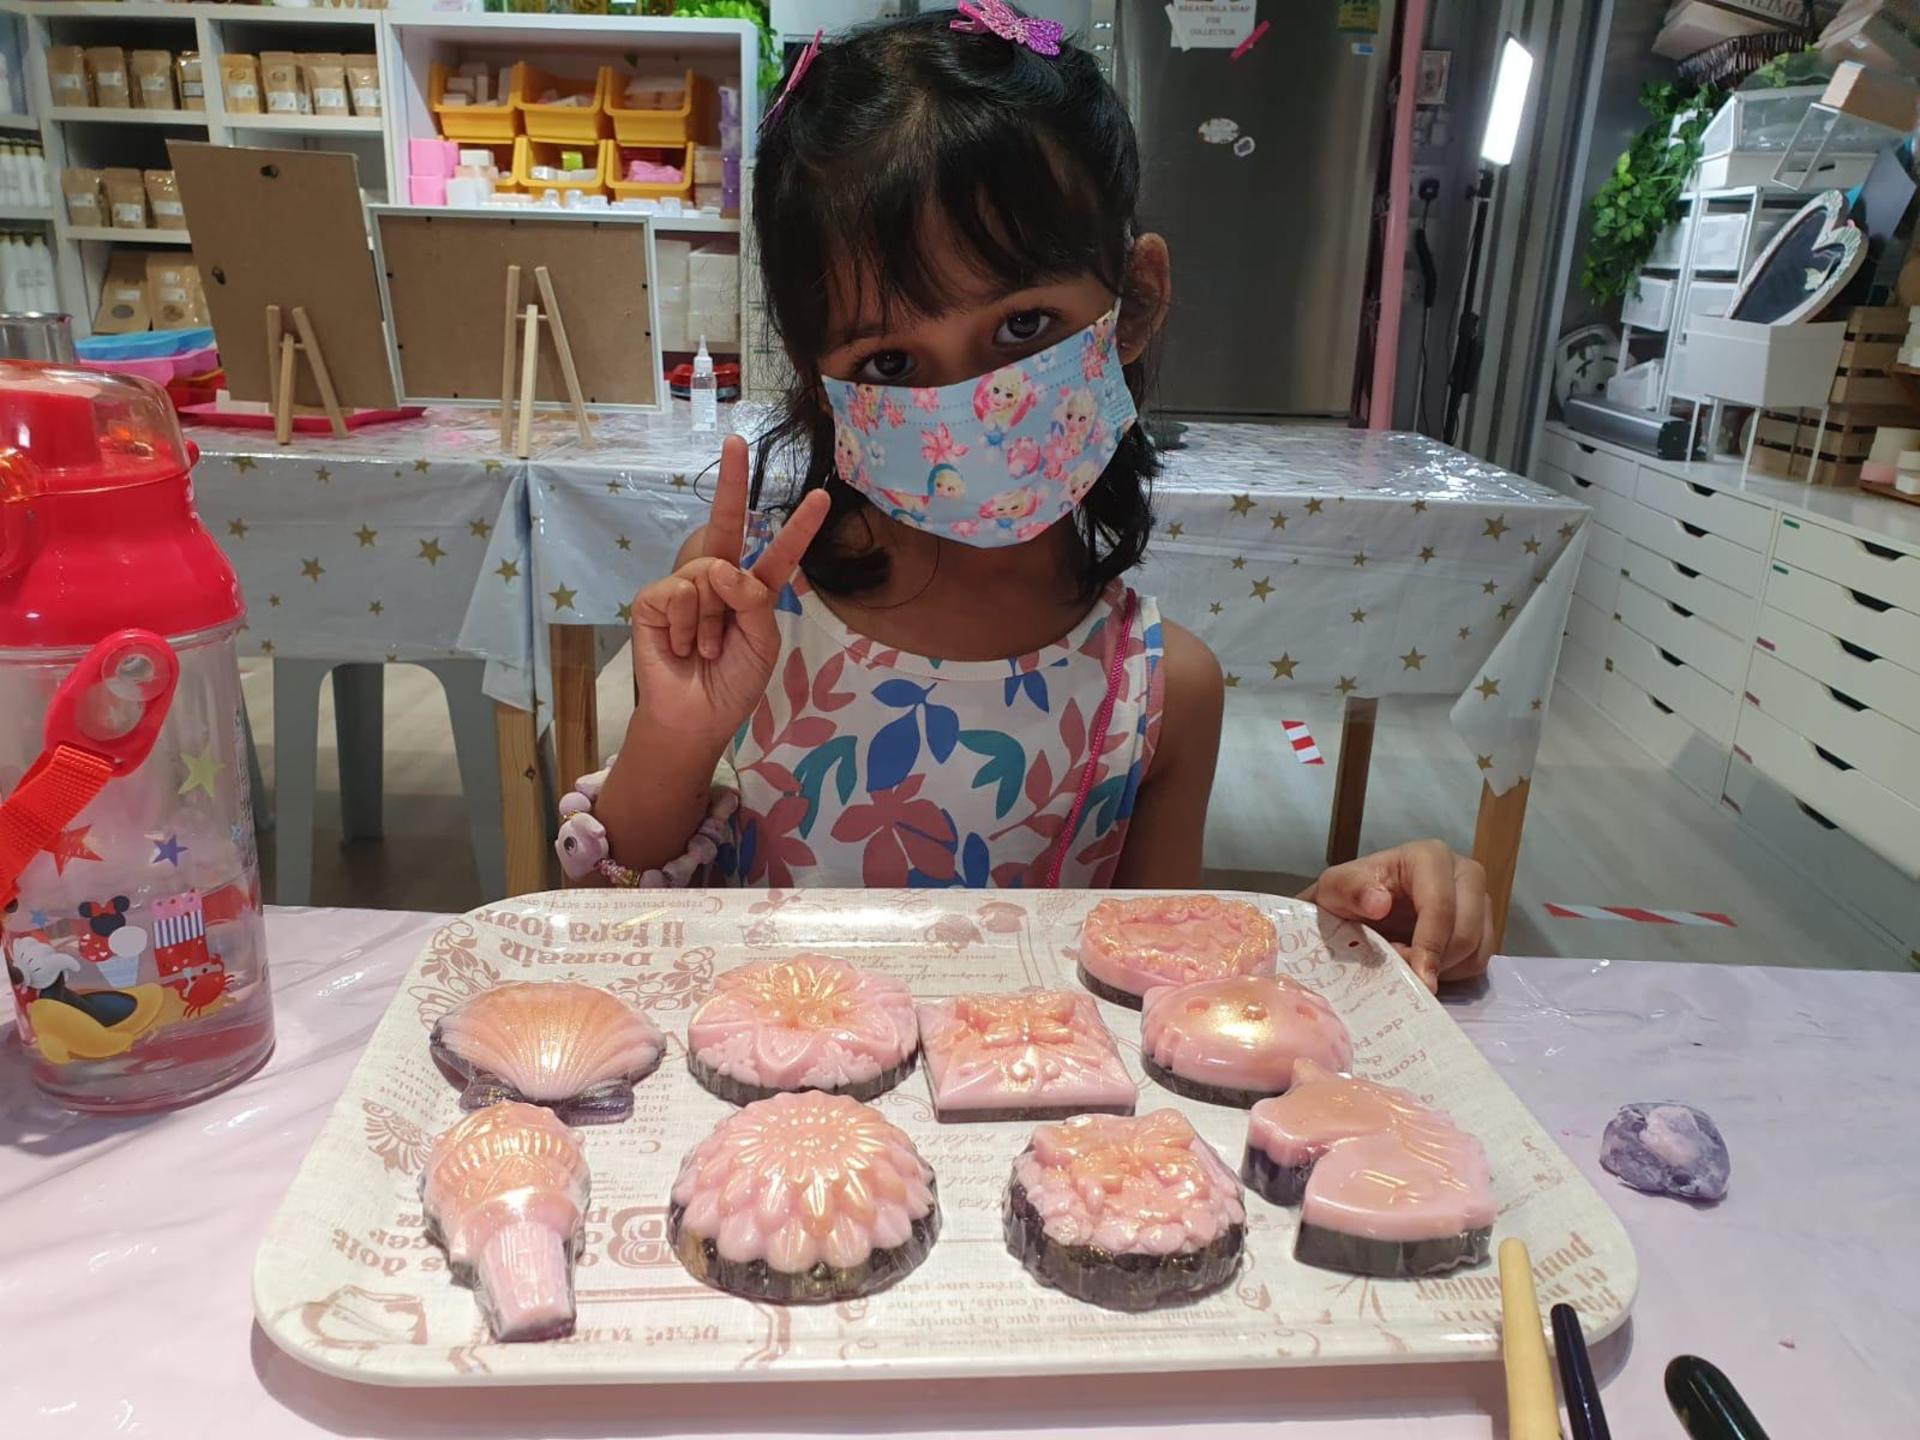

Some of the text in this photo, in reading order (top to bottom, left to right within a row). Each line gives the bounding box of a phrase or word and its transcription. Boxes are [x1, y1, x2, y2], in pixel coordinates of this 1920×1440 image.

[569, 920, 649, 949] fera
[498, 938, 654, 969] Demain
[332, 1230, 407, 1277] doit
